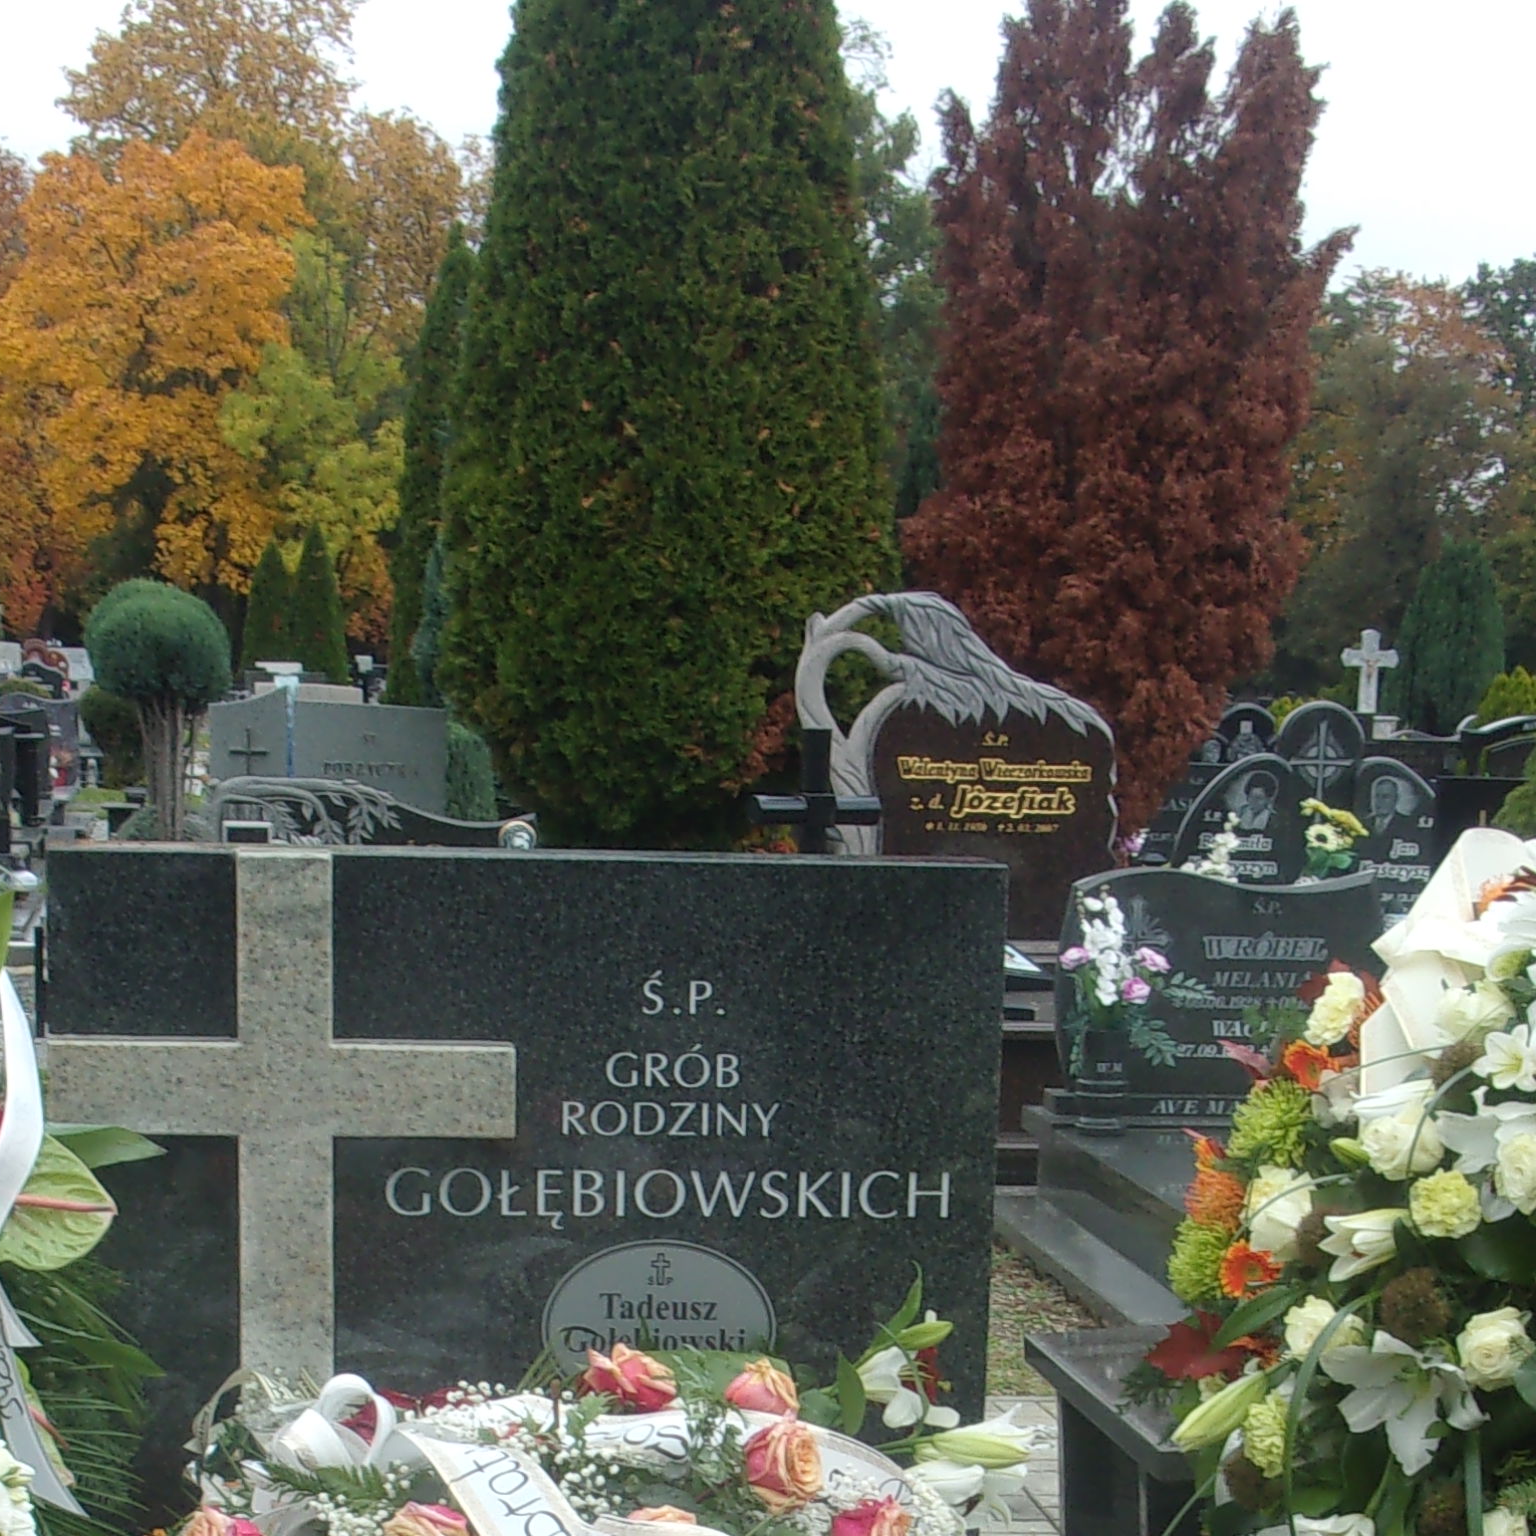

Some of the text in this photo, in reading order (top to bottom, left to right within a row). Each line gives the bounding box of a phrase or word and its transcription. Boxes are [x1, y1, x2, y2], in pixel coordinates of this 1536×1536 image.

[949, 784, 1077, 819] Józefiak
[1203, 931, 1328, 961] WRÓBEL
[641, 970, 727, 1017] Ś.P.
[605, 1044, 741, 1090] GRÓB
[562, 1101, 782, 1138] RODZINY
[384, 1167, 951, 1230] GOŁĘBIOWSKICH
[599, 1292, 718, 1321] Tadeusz
